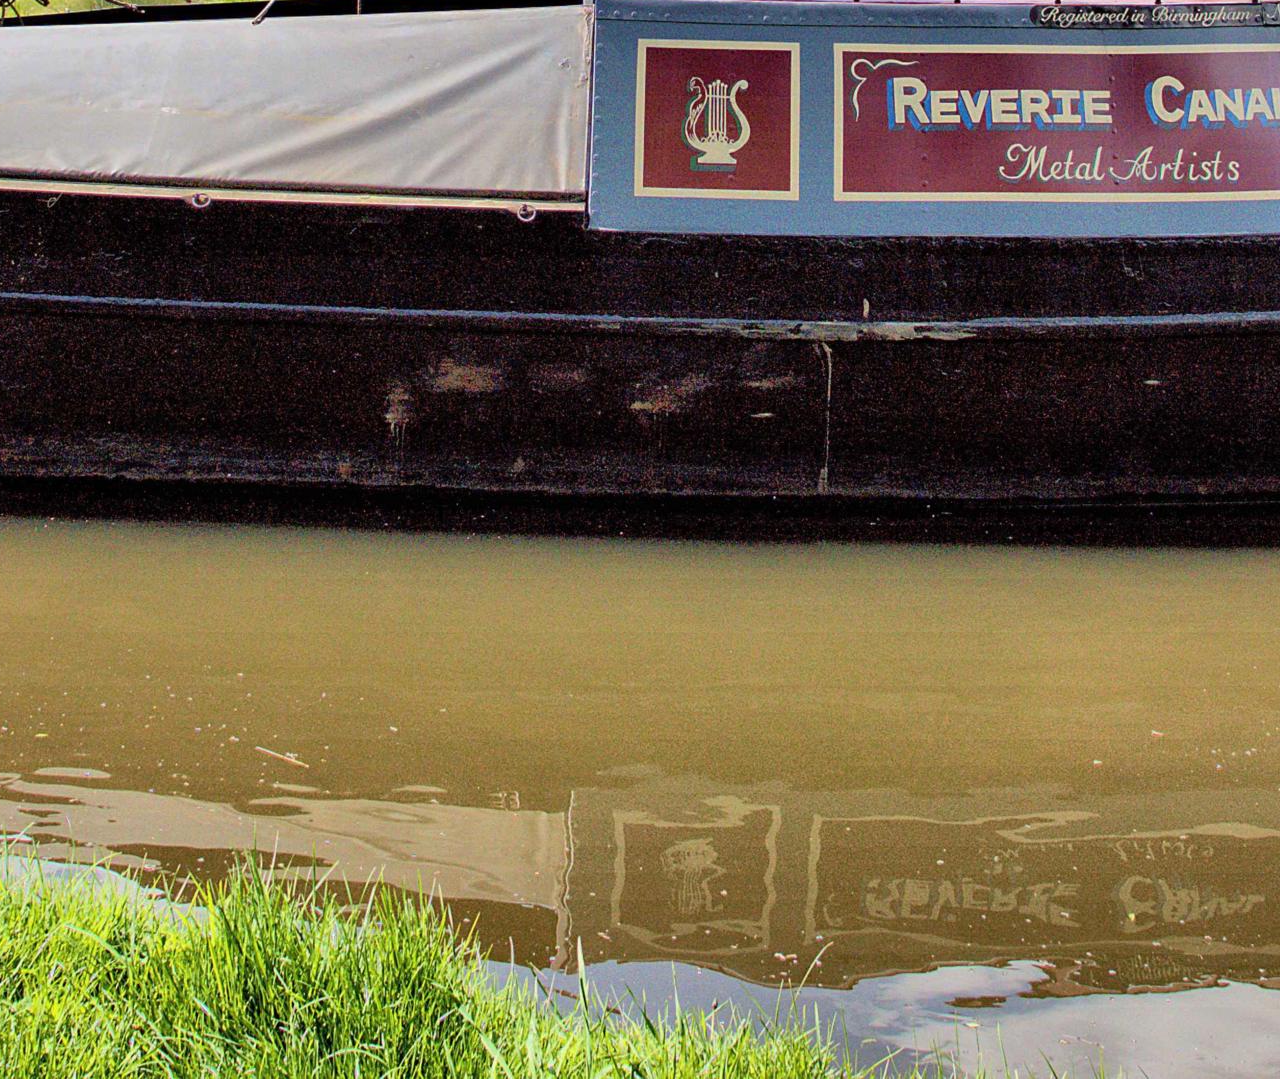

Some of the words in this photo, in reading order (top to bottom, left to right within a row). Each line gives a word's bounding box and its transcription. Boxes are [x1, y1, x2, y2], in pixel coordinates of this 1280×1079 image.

[1040, 5, 1130, 28] Registered
[1131, 9, 1145, 23] in
[1152, 5, 1251, 27] Birmingham
[891, 76, 1113, 125] REVERIE
[999, 142, 1106, 182] Metal
[1109, 145, 1241, 181] Artists
